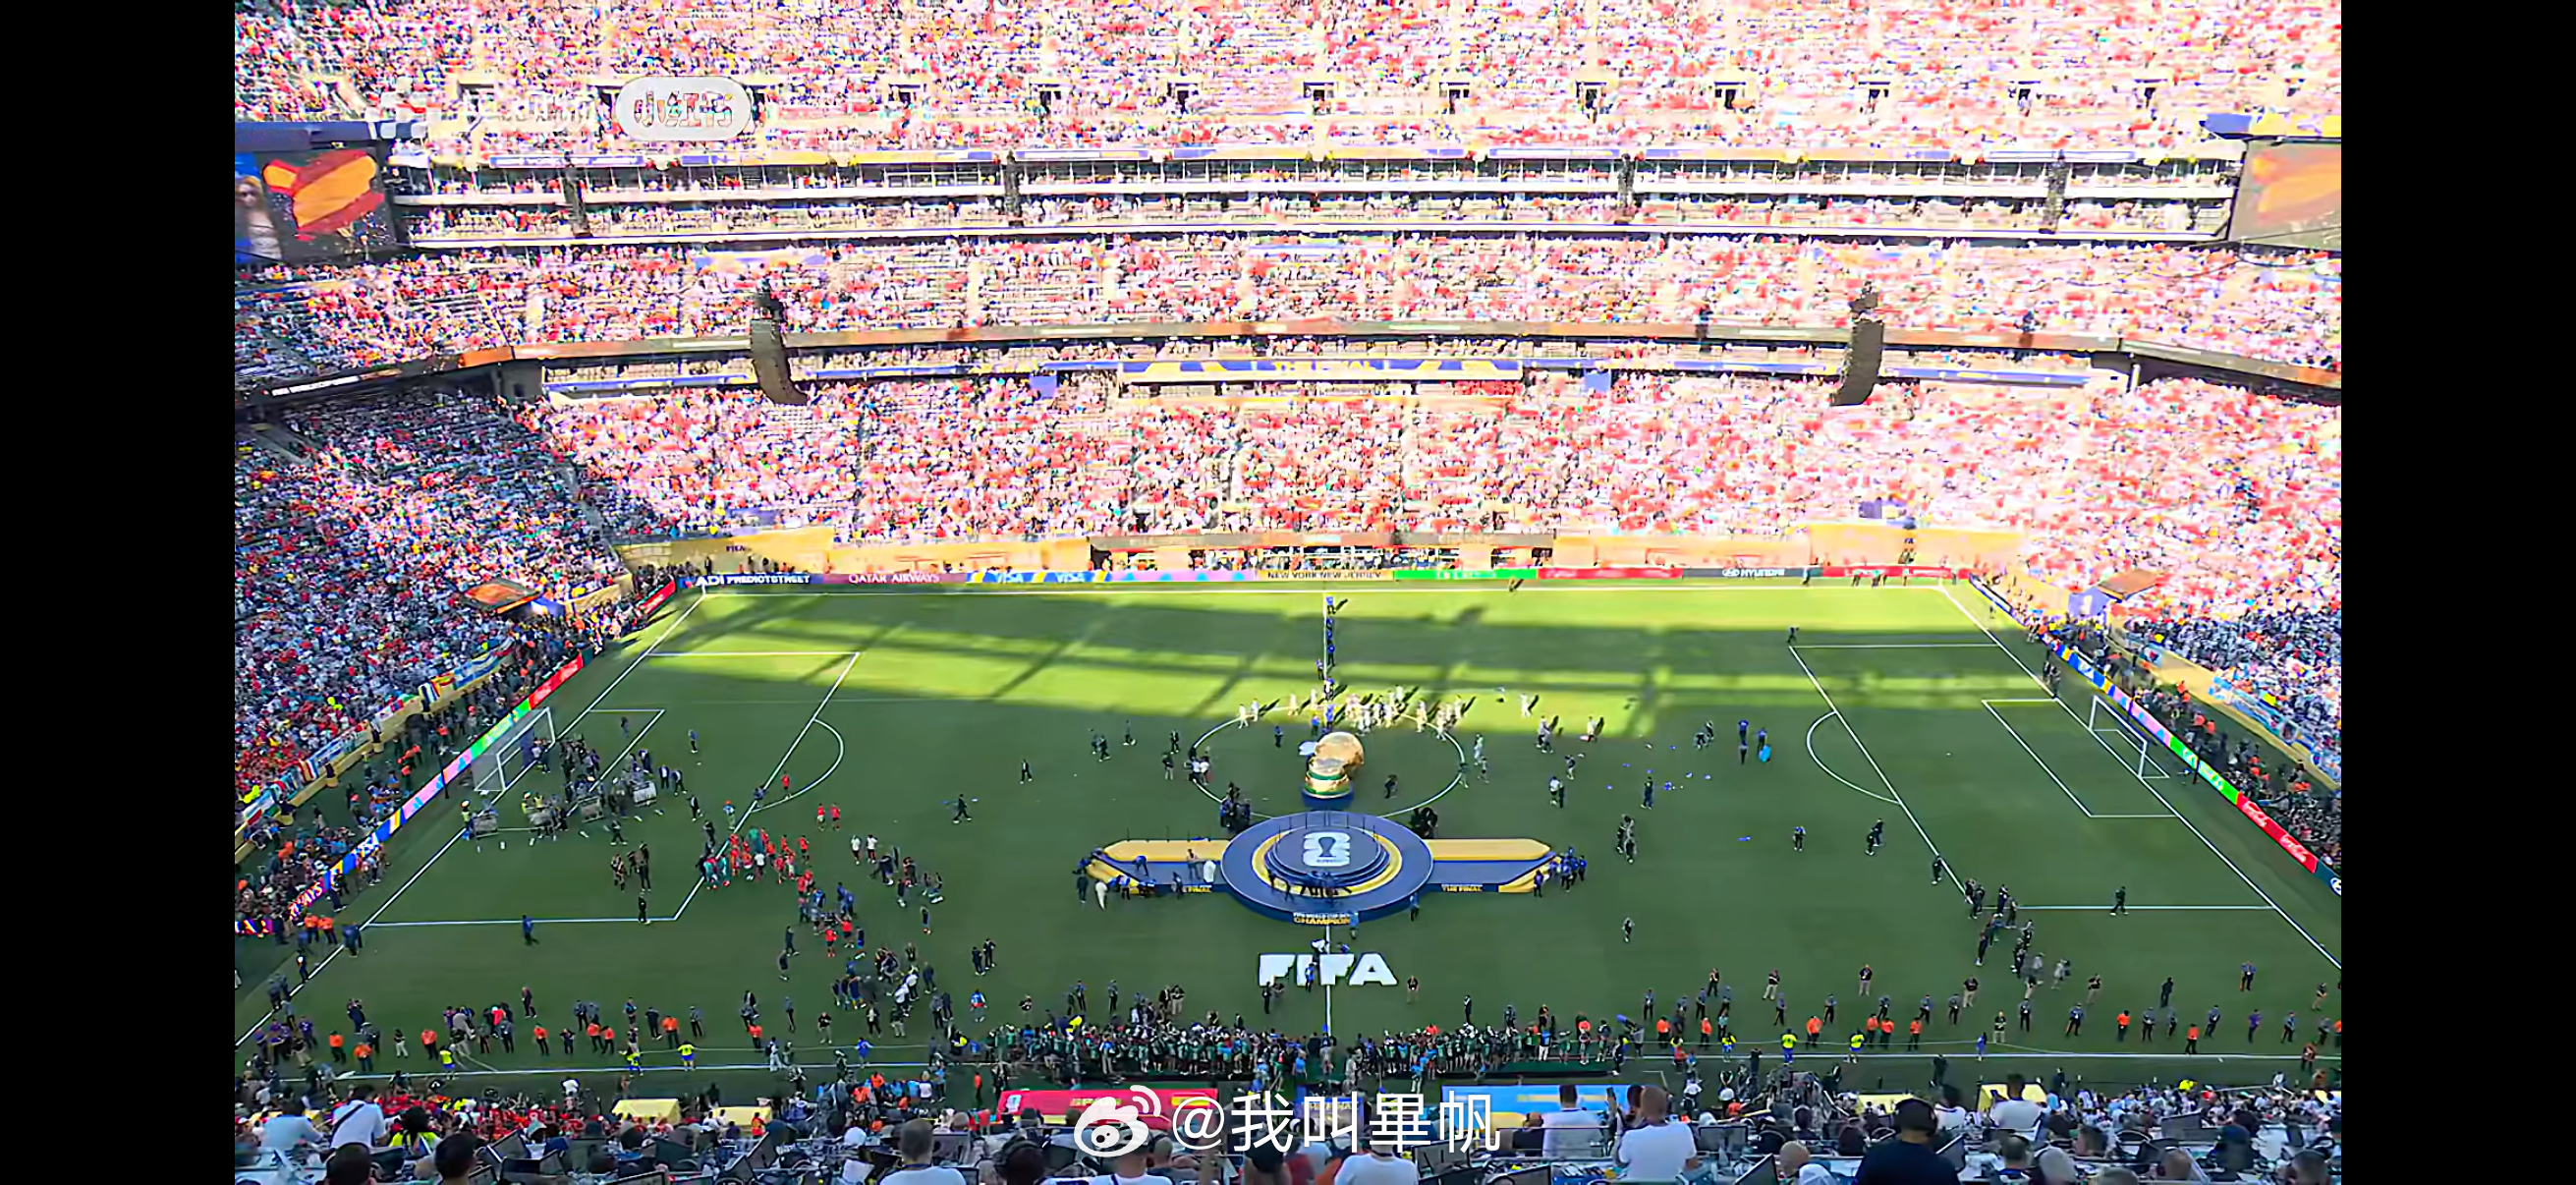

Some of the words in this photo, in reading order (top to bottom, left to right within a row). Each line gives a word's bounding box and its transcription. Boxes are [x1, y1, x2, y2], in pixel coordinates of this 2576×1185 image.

[848, 573, 887, 584] QATAR
[891, 572, 940, 584] AIRWAYS
[1740, 568, 1786, 578] HYUNDAI
[1259, 953, 1398, 987] FIFA
